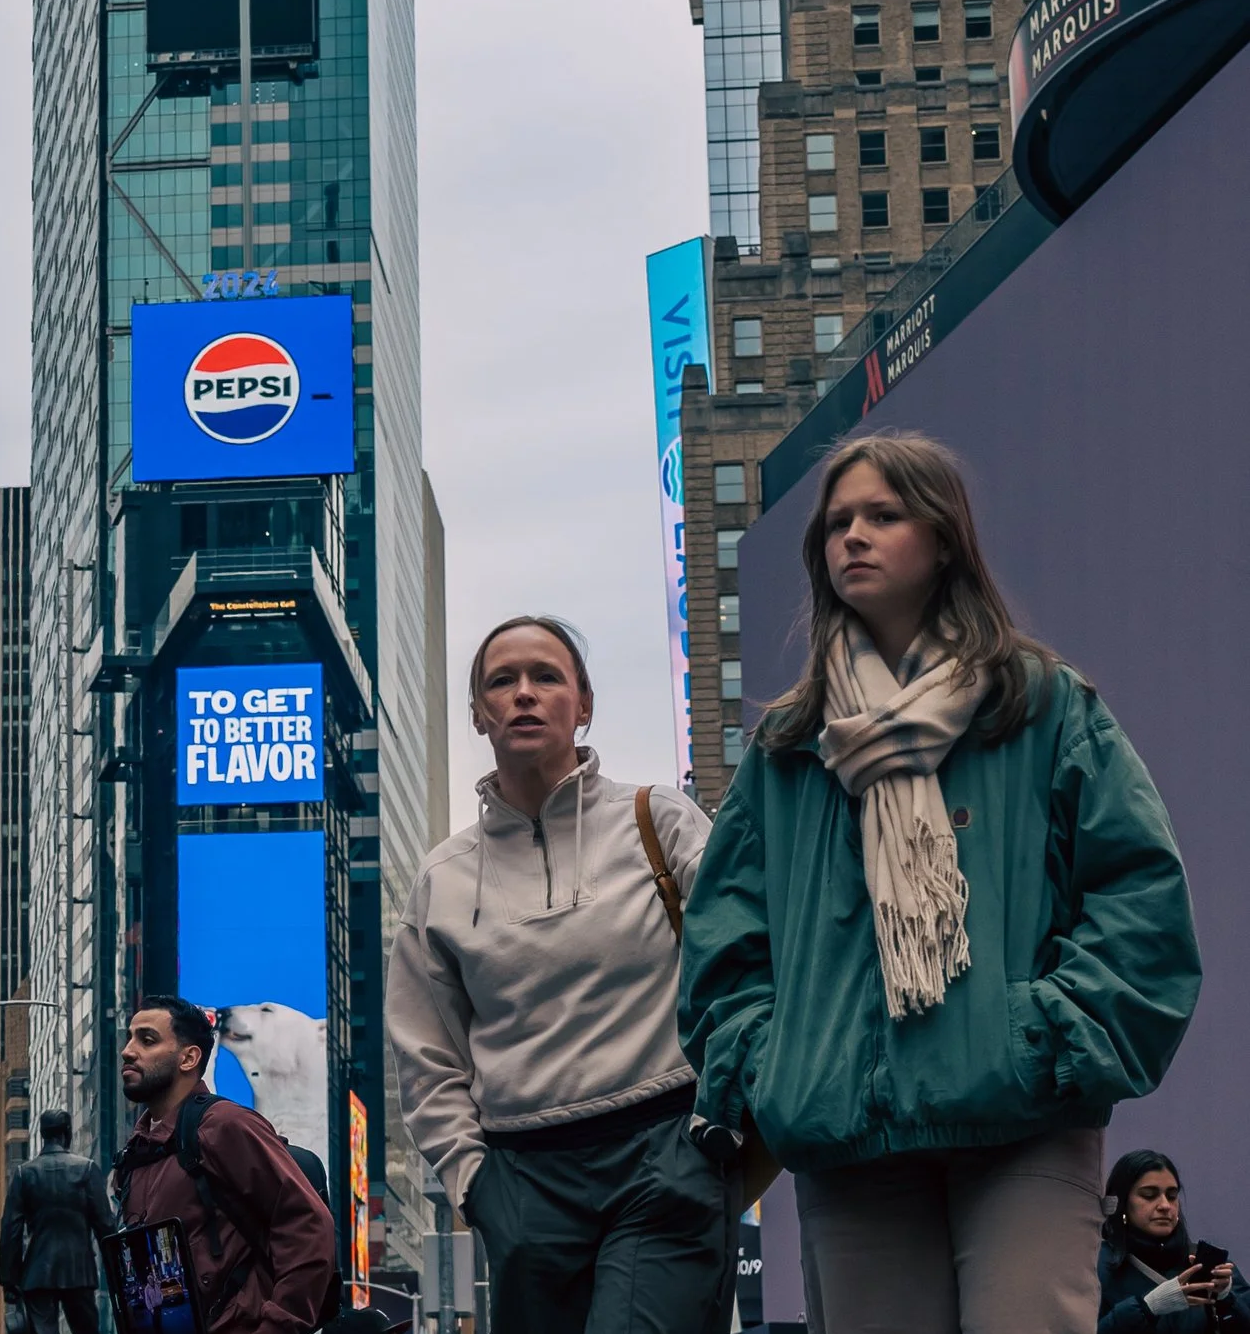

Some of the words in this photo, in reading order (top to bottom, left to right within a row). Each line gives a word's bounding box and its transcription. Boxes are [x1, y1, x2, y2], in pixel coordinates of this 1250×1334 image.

[201, 269, 280, 300] 2024
[886, 294, 937, 356] MARRIOTT
[886, 330, 932, 384] MARQUIS
[193, 375, 293, 400] PEPSI
[189, 691, 236, 715] TO
[242, 687, 313, 713] GET
[190, 718, 221, 744] TO
[224, 715, 313, 743] BETTER
[186, 743, 317, 785] FLAVOR
